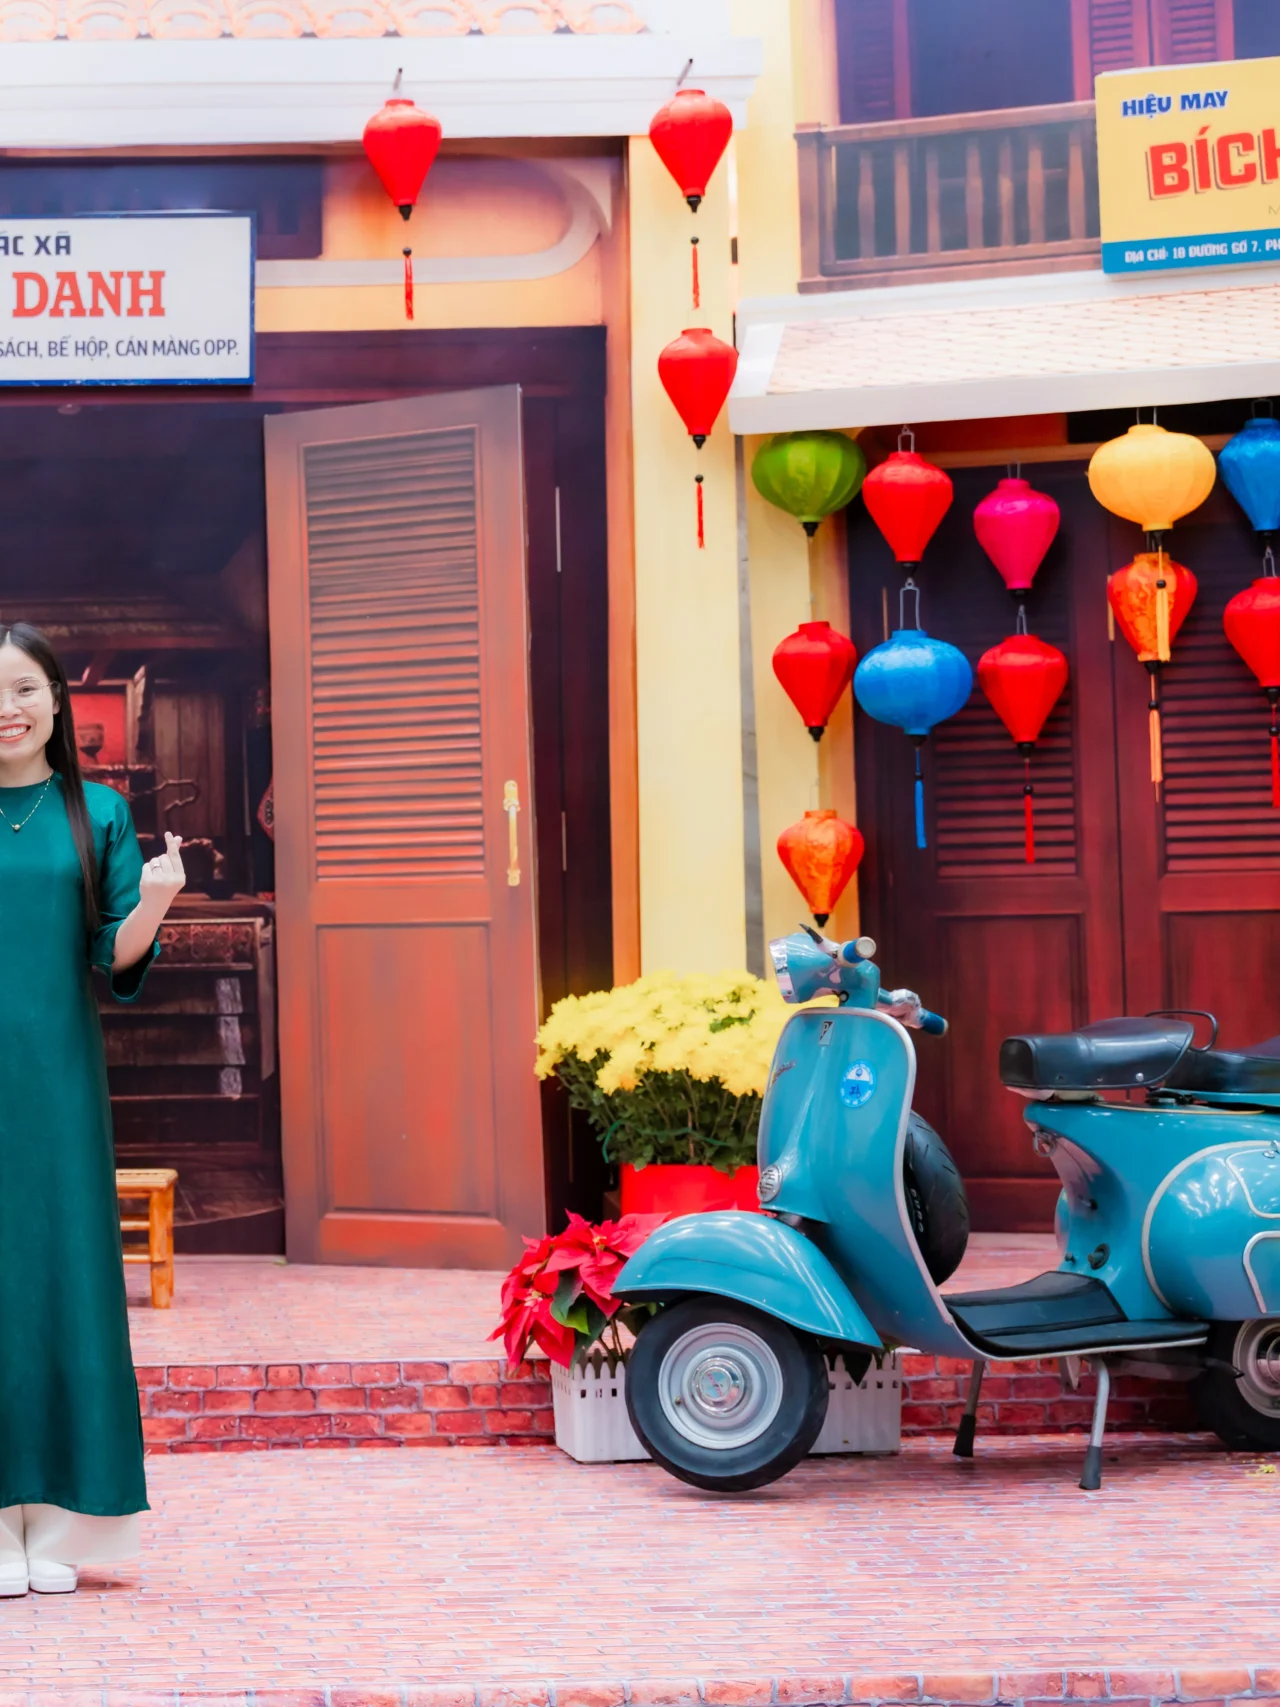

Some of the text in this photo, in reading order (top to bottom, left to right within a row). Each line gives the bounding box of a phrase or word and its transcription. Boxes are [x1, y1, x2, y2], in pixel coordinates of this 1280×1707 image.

[1122, 91, 1229, 118] HIỆU MAY
[12, 271, 166, 318] DANH
[75, 336, 110, 361] HỘP,
[116, 336, 150, 357] CÁN
[153, 335, 200, 356] MÀNG
[204, 338, 239, 356] OPP.
